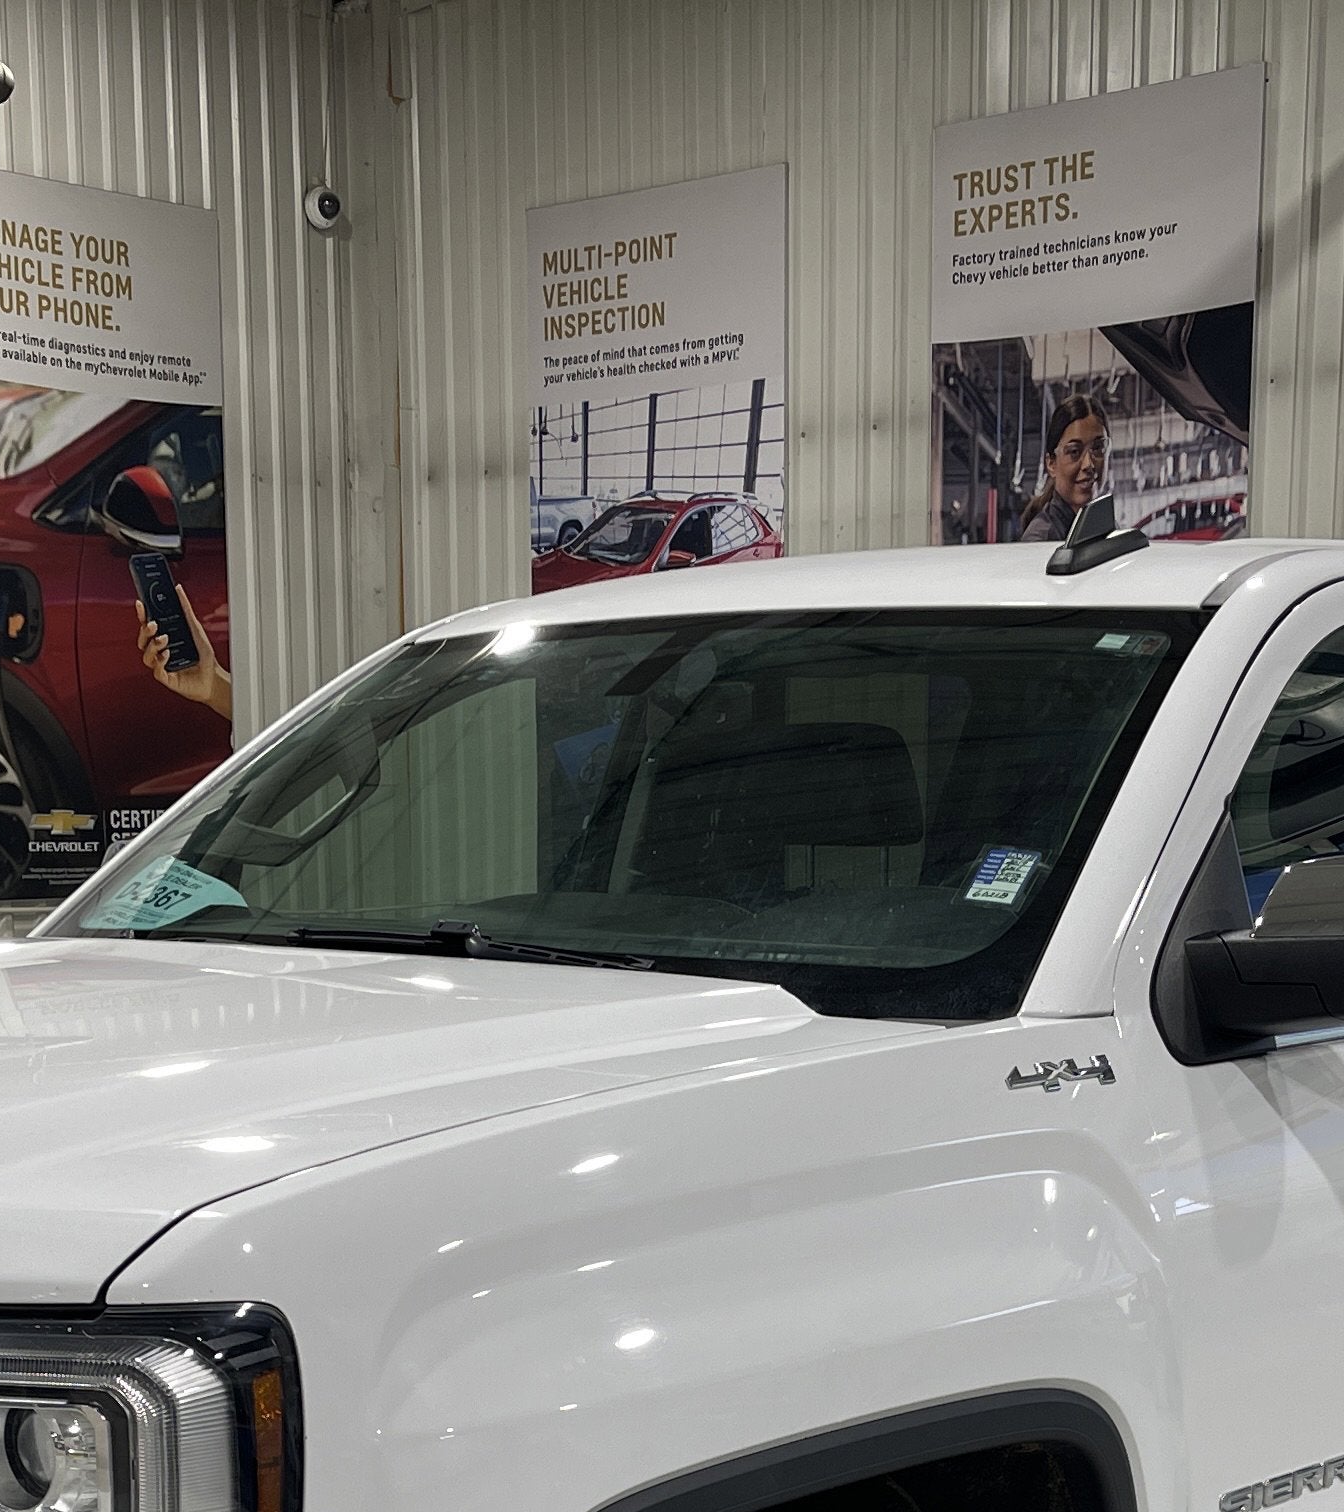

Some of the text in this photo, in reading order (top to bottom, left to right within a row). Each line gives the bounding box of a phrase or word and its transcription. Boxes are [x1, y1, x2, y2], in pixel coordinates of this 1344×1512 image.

[952, 150, 1095, 201] TRUST THE
[953, 193, 1079, 238] EXPERTS.
[69, 231, 131, 267] YOUR
[542, 232, 678, 277] MULTI-POINT
[952, 222, 1178, 268] Factory trained technicians know your
[71, 266, 133, 301] FROM
[952, 247, 1150, 286] Chevy vehicle better than anyone.
[542, 273, 629, 309] VEHICLE
[37, 293, 121, 332] PHONE.
[543, 301, 666, 341] INSPECTION
[2, 347, 47, 366] available
[50, 356, 63, 368] on
[65, 357, 82, 371] the
[84, 362, 147, 380] myChevrolet
[149, 368, 180, 383] Mobile
[48, 337, 106, 358] diagnostics
[108, 348, 127, 361] and
[128, 351, 155, 366] enjoy
[157, 354, 192, 368] remote
[543, 332, 745, 370] The peace of mind that comes from getting
[543, 373, 564, 388] your
[566, 365, 605, 383] vehicle's
[607, 362, 637, 378] health
[638, 355, 678, 373] checked
[679, 355, 701, 369] with
[703, 355, 710, 366] a
[28, 841, 100, 852] CHEVROLET
